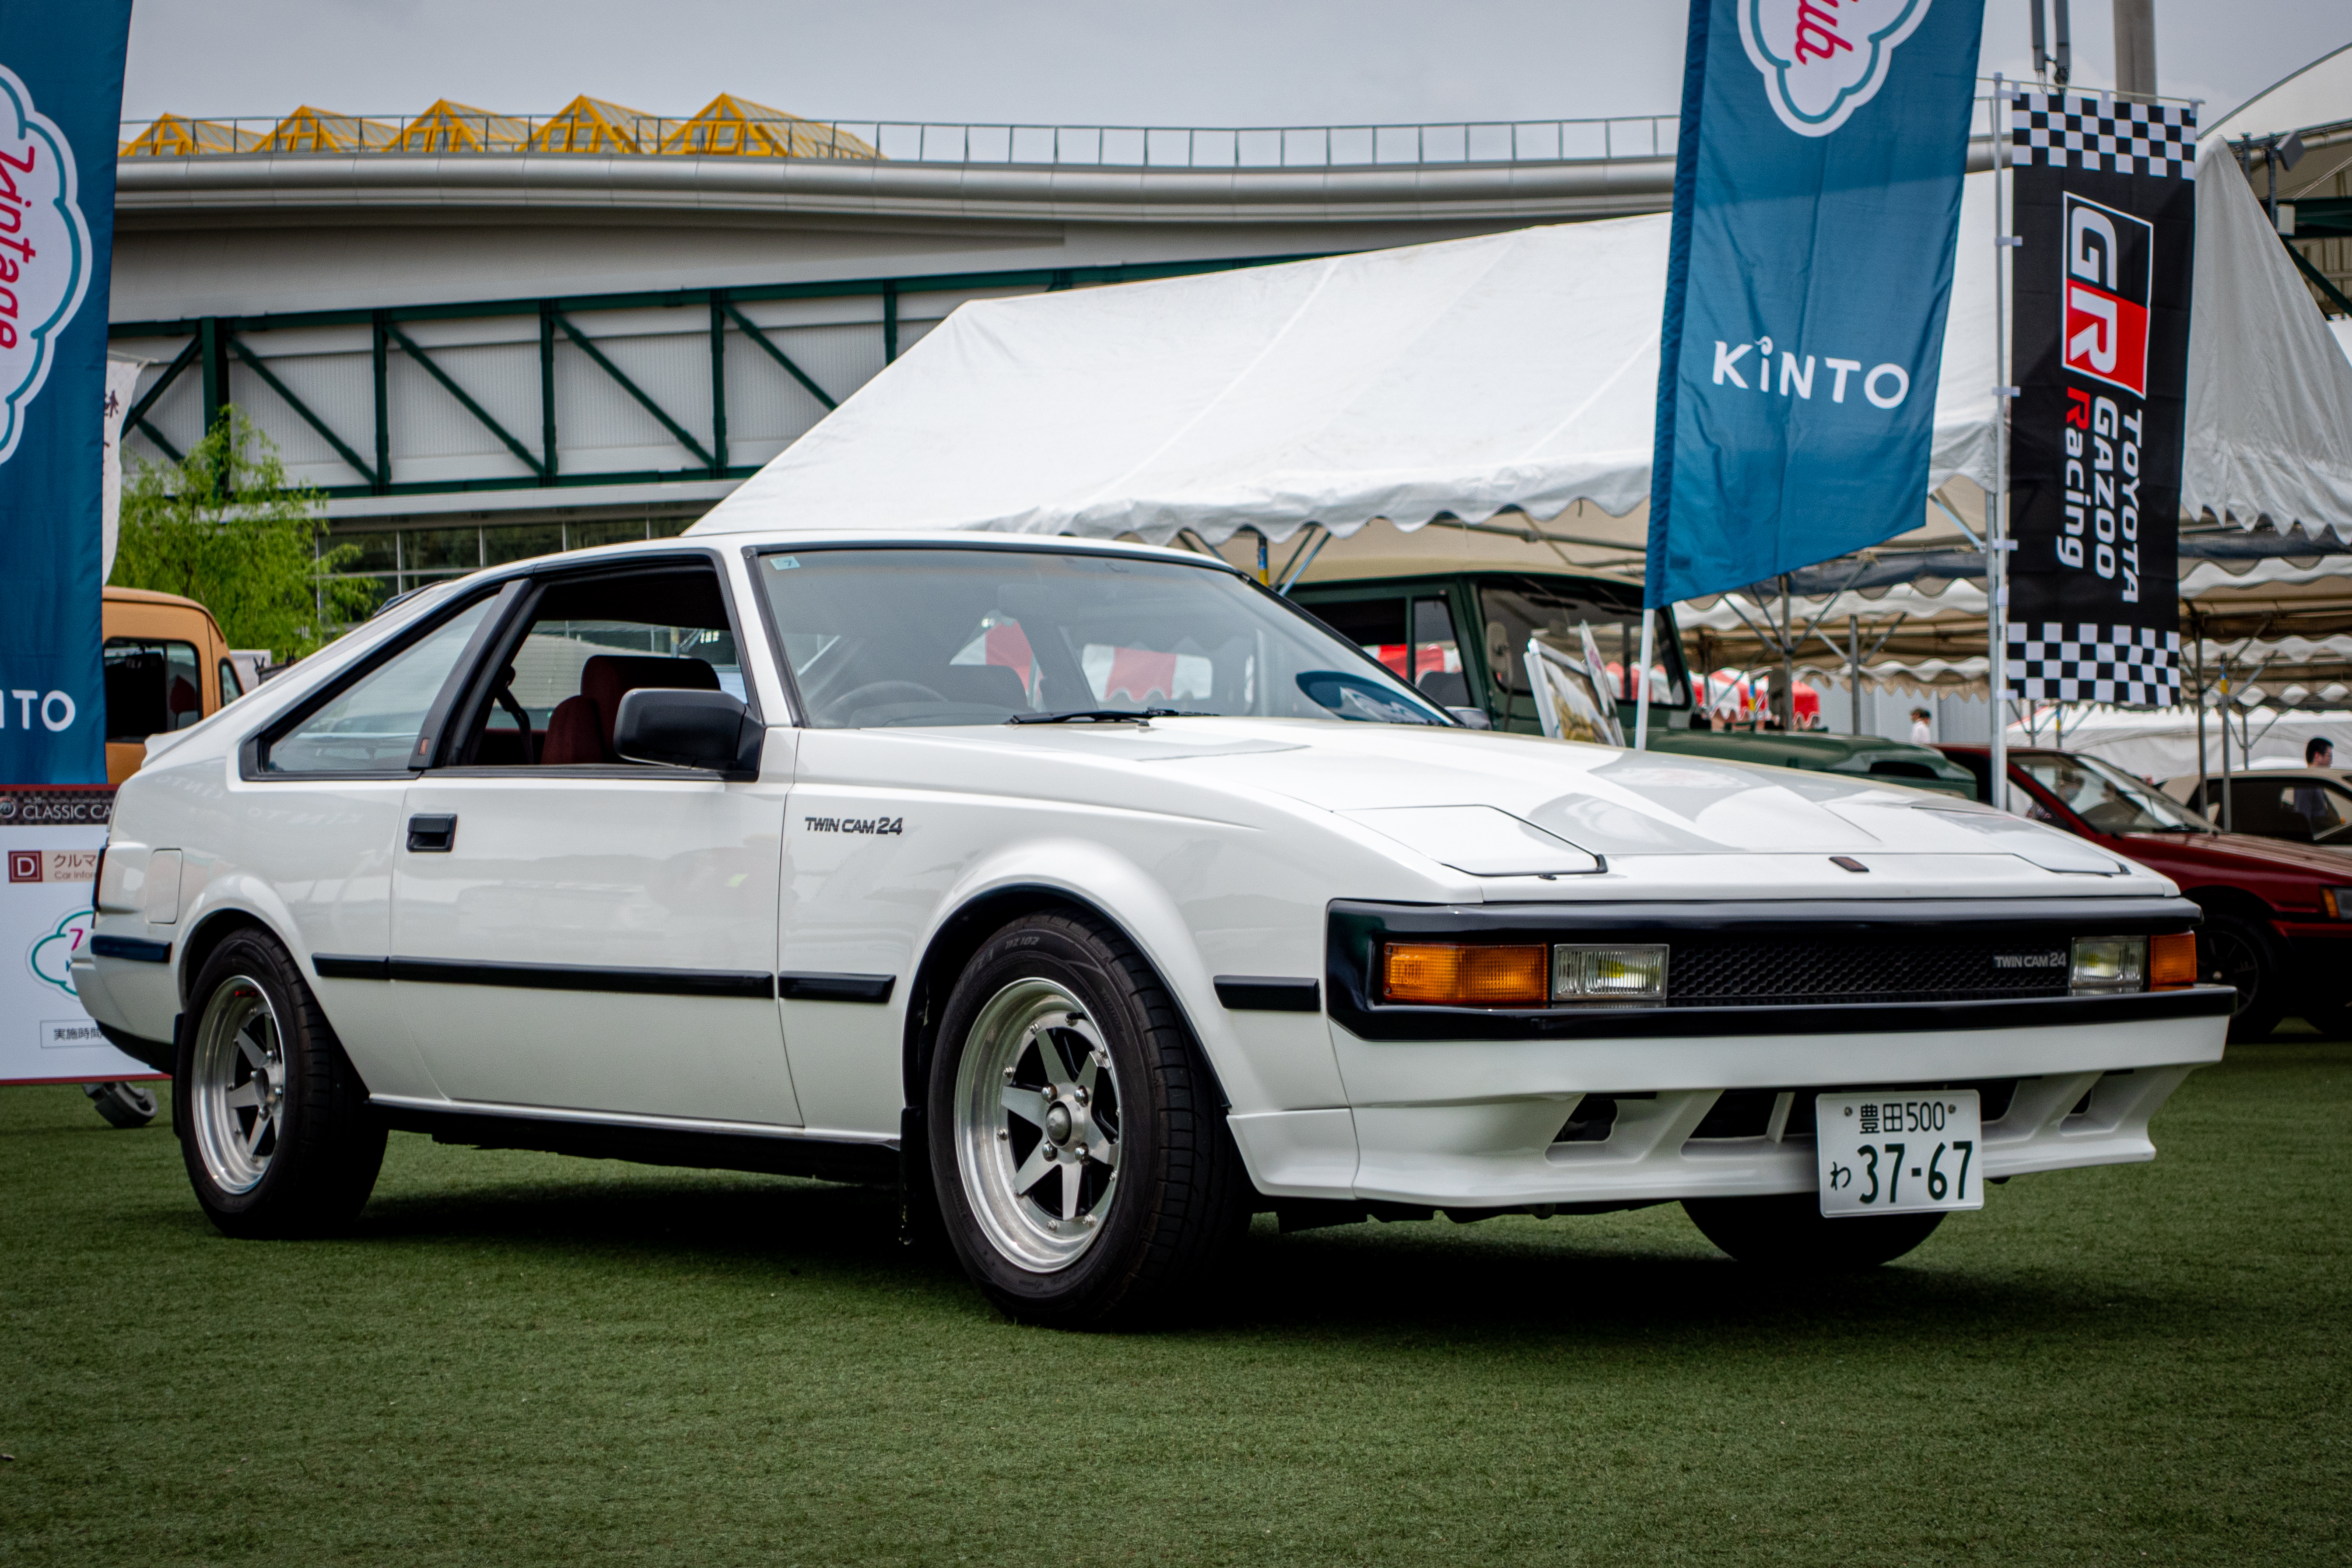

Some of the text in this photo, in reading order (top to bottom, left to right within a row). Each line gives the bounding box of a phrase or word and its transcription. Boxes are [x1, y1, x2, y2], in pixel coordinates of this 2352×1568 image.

[1795, 0, 1859, 65] ub
[2070, 206, 2117, 374] GR
[2057, 386, 2090, 569] Racing
[2094, 396, 2118, 579] GAZOO
[2122, 409, 2143, 603] TOYOTA
[0, 689, 76, 732] TO
[23, 804, 87, 820] CLASSIC
[805, 816, 903, 835] TWIN CAM 24
[17, 857, 35, 877] D
[53, 854, 97, 868] クルマ
[1994, 952, 2066, 968] TWIN CAM 24
[1830, 1140, 1973, 1204] わ 37-67
